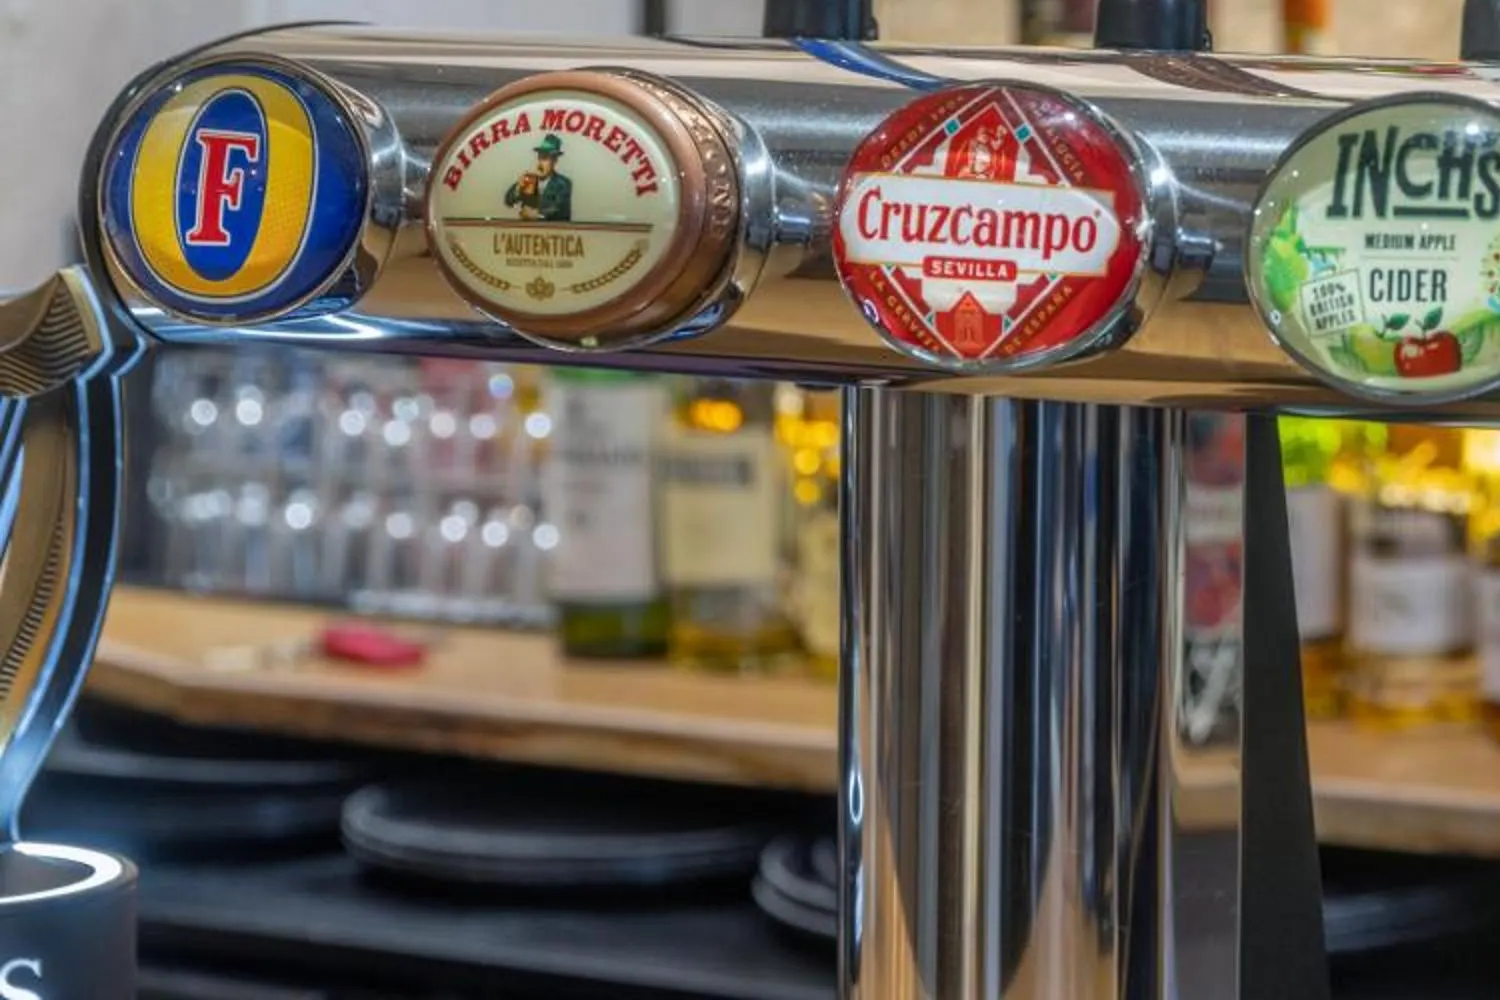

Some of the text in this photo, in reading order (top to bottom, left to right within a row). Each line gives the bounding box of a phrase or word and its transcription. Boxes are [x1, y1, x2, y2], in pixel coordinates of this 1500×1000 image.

[443, 110, 531, 191] BIRRA
[540, 109, 659, 198] MORETTI
[186, 128, 260, 247] F
[856, 185, 1100, 260] Cruzcampo
[493, 232, 585, 258] L'AUTENTICA
[1364, 233, 1456, 251] MEDIUM APPLE
[931, 259, 1009, 278] SEVILLA
[1312, 281, 1347, 301] 100%
[1369, 268, 1448, 303] CIDER
[1315, 309, 1357, 332] APPLES
